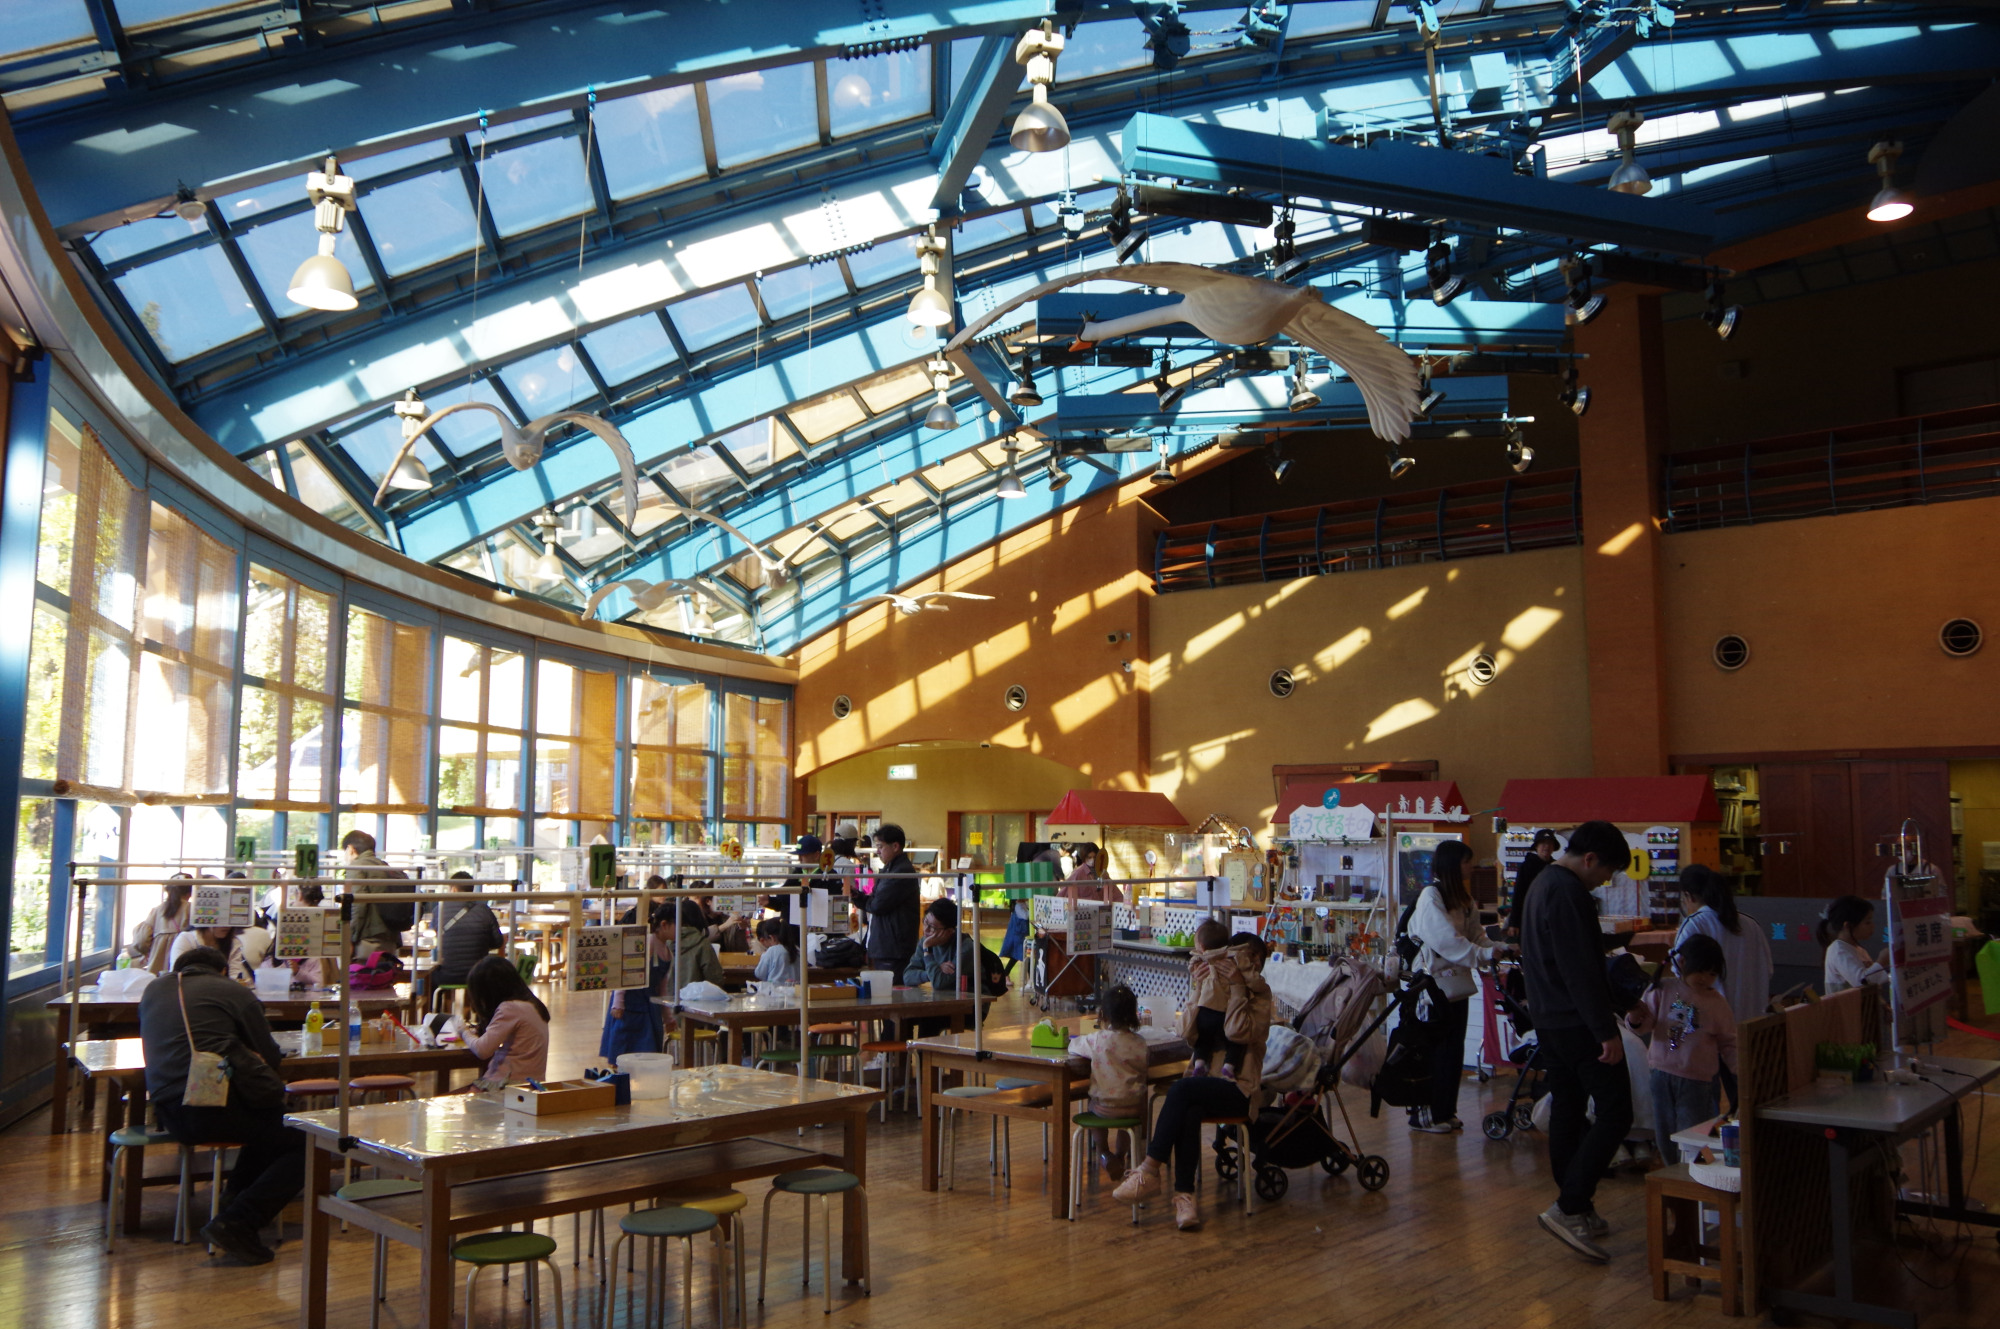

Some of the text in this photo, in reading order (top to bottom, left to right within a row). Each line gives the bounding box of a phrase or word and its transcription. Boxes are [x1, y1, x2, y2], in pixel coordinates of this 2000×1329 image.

[1291, 812, 1371, 836] きょうできるもの
[238, 841, 254, 858] 21
[722, 844, 729, 853] 7
[732, 845, 742, 858] 5
[299, 849, 317, 872] 19
[594, 851, 613, 880] 17
[822, 853, 833, 869] 3
[1633, 854, 1641, 873] 1
[1915, 921, 1943, 947] 満席
[516, 956, 535, 981] 19
